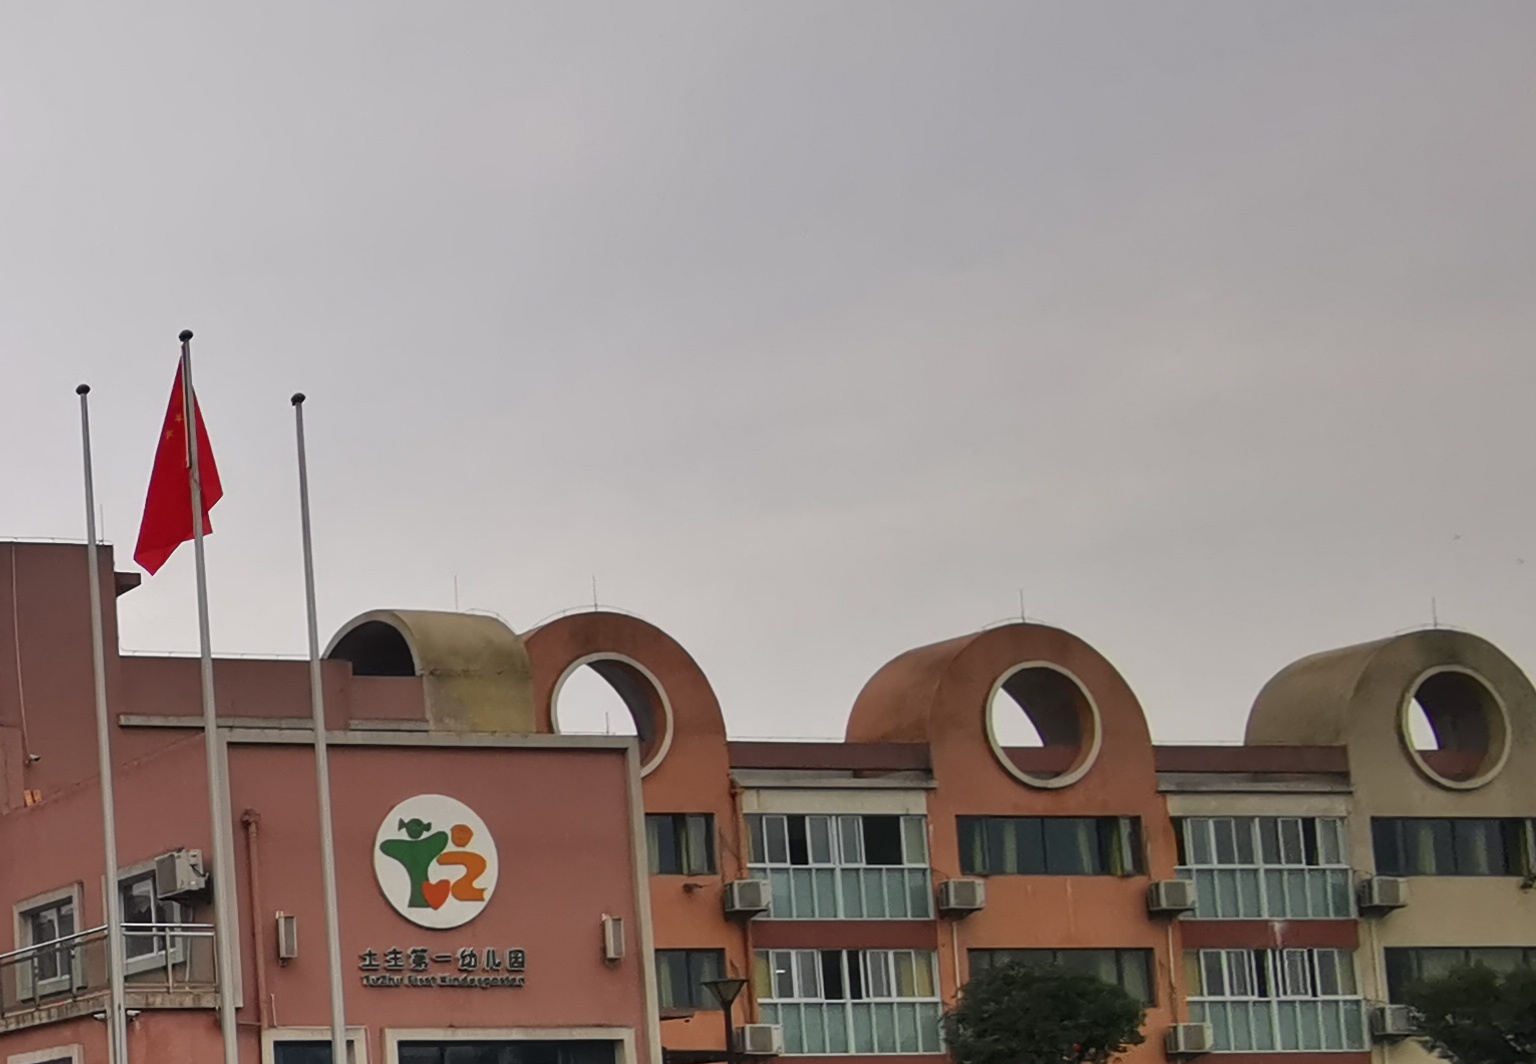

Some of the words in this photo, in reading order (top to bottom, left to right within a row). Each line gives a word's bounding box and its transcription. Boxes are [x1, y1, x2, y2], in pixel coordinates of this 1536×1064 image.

[359, 947, 526, 972] 土主第一幼儿园
